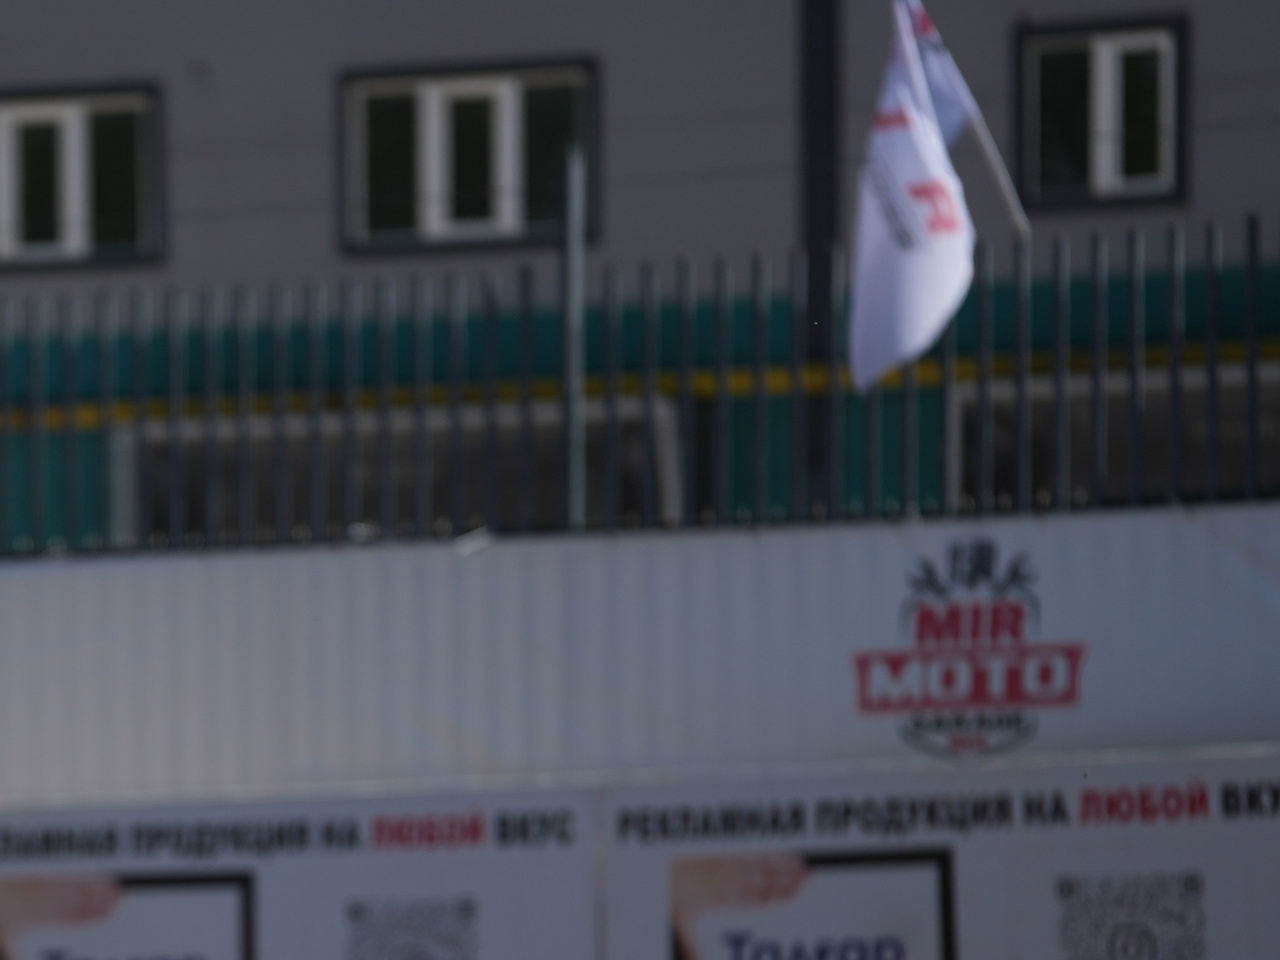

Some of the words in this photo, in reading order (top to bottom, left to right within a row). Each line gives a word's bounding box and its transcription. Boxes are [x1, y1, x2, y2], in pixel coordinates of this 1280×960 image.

[915, 601, 1025, 643] MIR
[870, 653, 1070, 702] MOTO
[496, 810, 573, 845] ВКУС
[617, 803, 805, 843] РЕКЛАМНАЯ
[816, 794, 1014, 836] ПРОДУКЦИЯ
[1023, 792, 1070, 827] НА
[1080, 780, 1210, 823] ЛЮБОЙ
